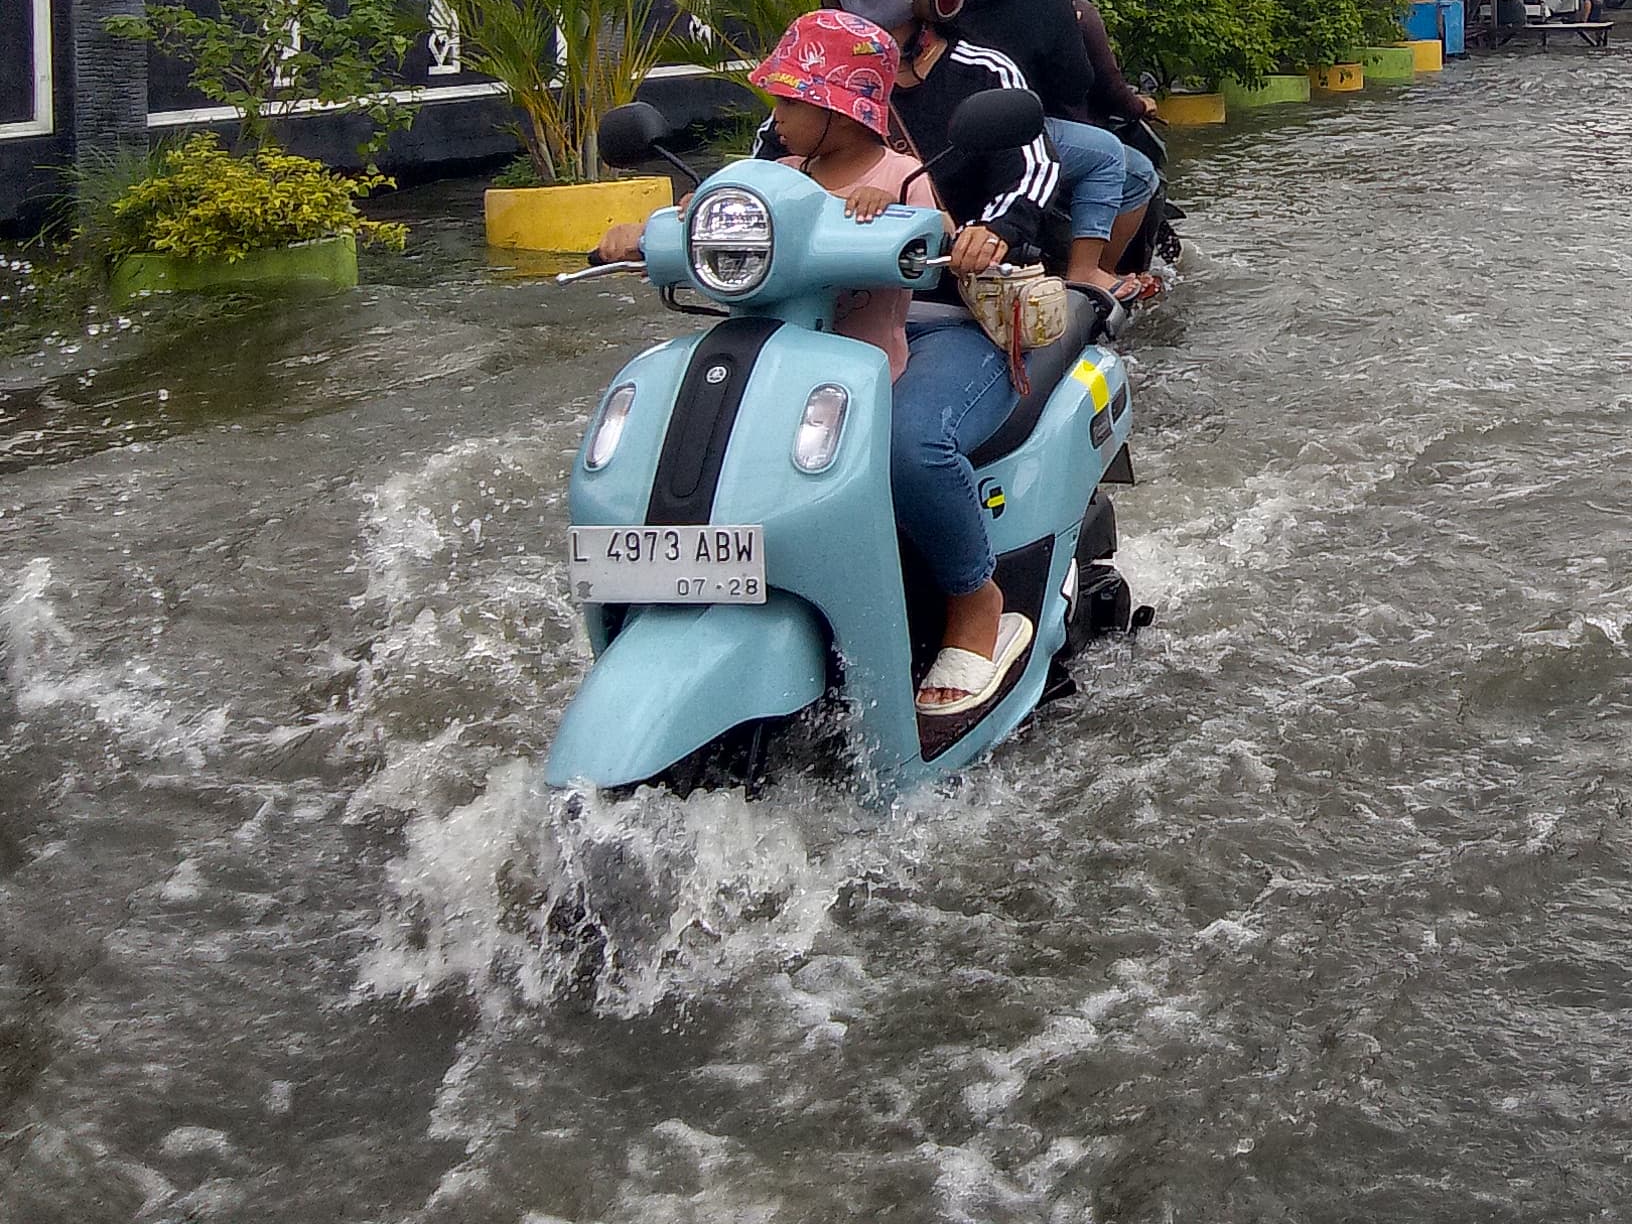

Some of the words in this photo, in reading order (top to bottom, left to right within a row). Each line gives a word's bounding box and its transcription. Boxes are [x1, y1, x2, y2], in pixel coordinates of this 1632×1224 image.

[572, 532, 588, 563] L
[607, 531, 680, 562] 4973
[696, 531, 754, 563] ABW
